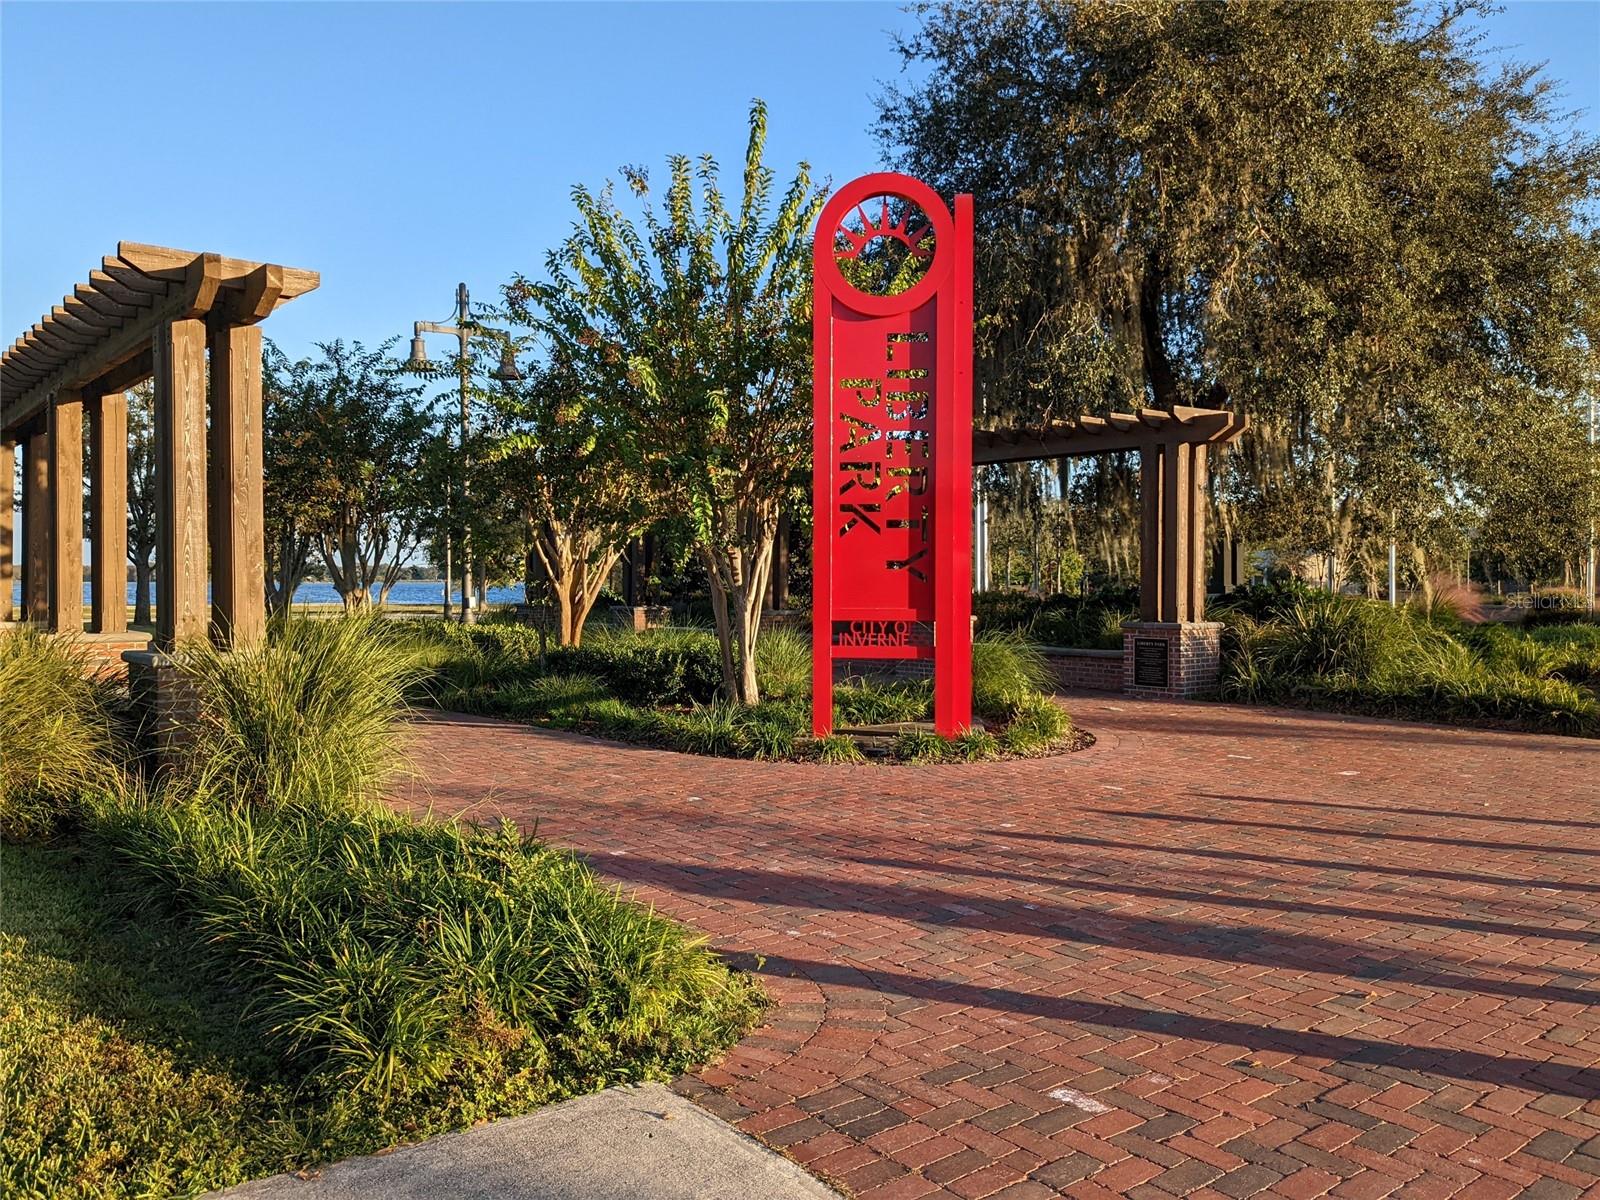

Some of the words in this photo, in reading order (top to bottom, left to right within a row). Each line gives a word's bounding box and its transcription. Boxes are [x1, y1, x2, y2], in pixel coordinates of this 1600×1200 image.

[840, 379, 881, 537] PARK
[886, 333, 928, 582] LIBERTY
[839, 633, 929, 647] INVERNE
[850, 620, 888, 633] CITY
